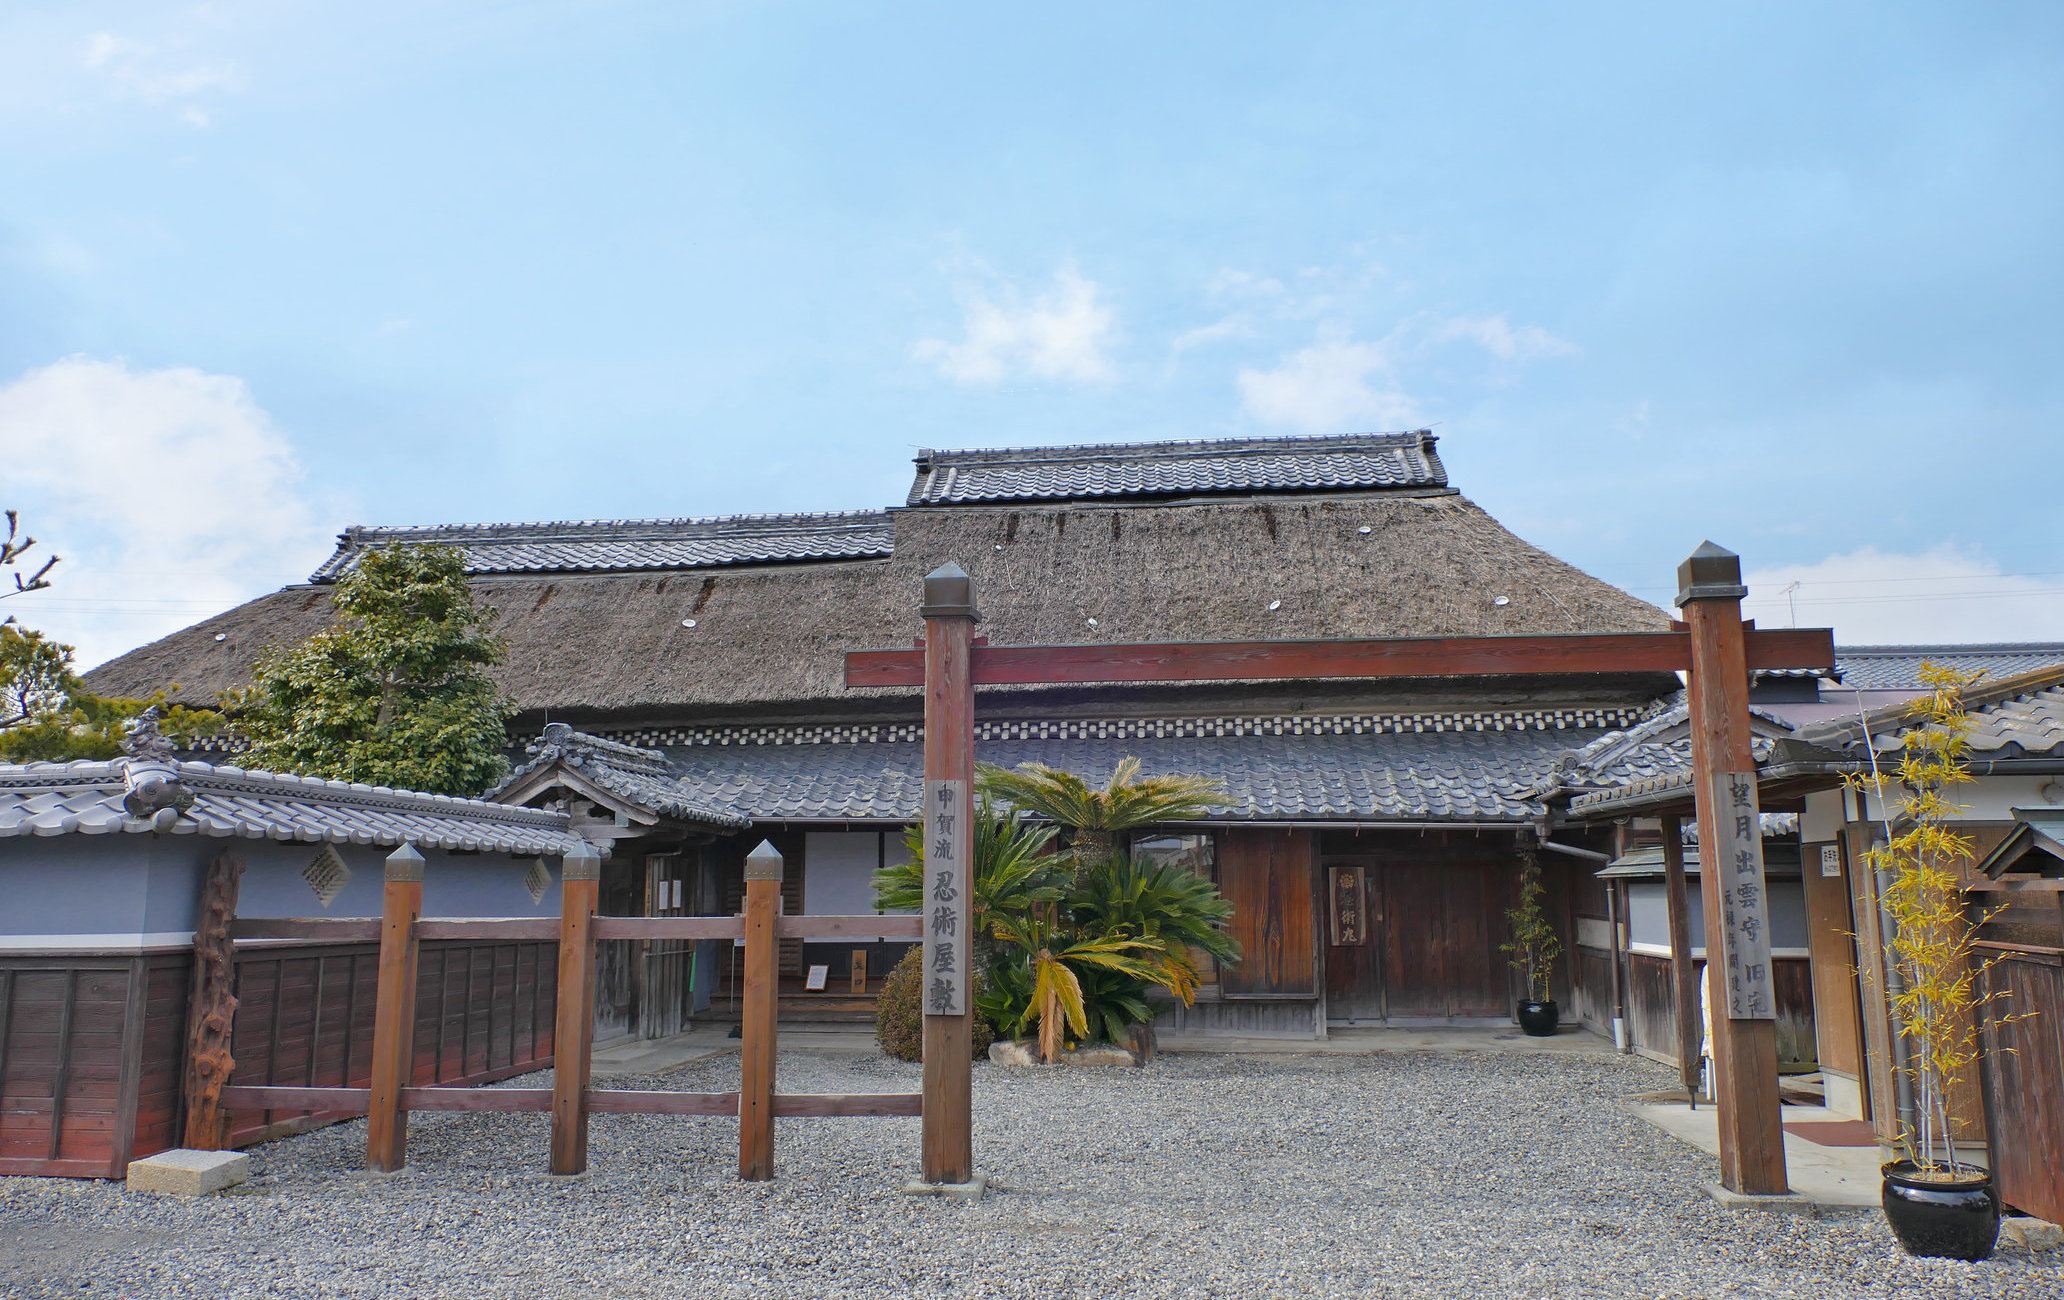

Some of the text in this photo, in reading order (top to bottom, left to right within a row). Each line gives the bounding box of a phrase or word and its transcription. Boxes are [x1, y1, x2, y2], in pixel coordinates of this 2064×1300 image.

[930, 783, 958, 1011] 甲賀流忍術屋敷
